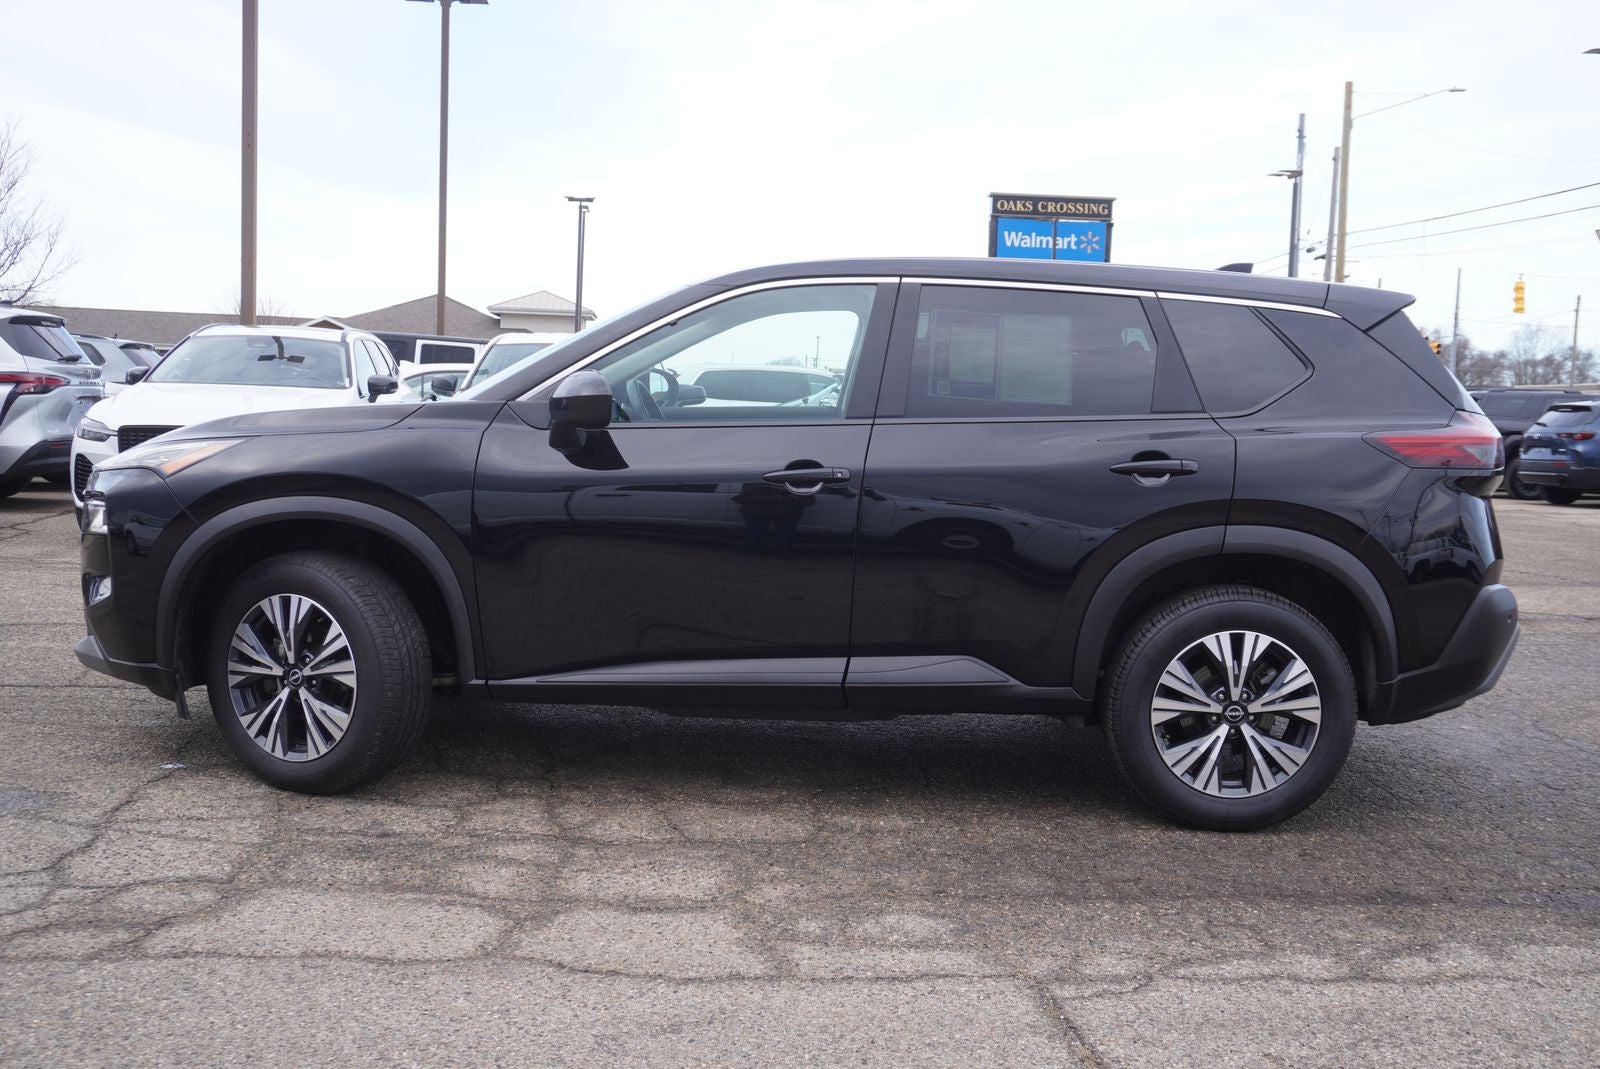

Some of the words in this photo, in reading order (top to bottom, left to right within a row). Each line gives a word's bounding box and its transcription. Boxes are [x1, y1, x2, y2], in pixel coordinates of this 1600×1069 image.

[997, 199, 1033, 212] OAKS
[1037, 201, 1109, 215] CROSSING
[1003, 231, 1078, 250] Walmart
